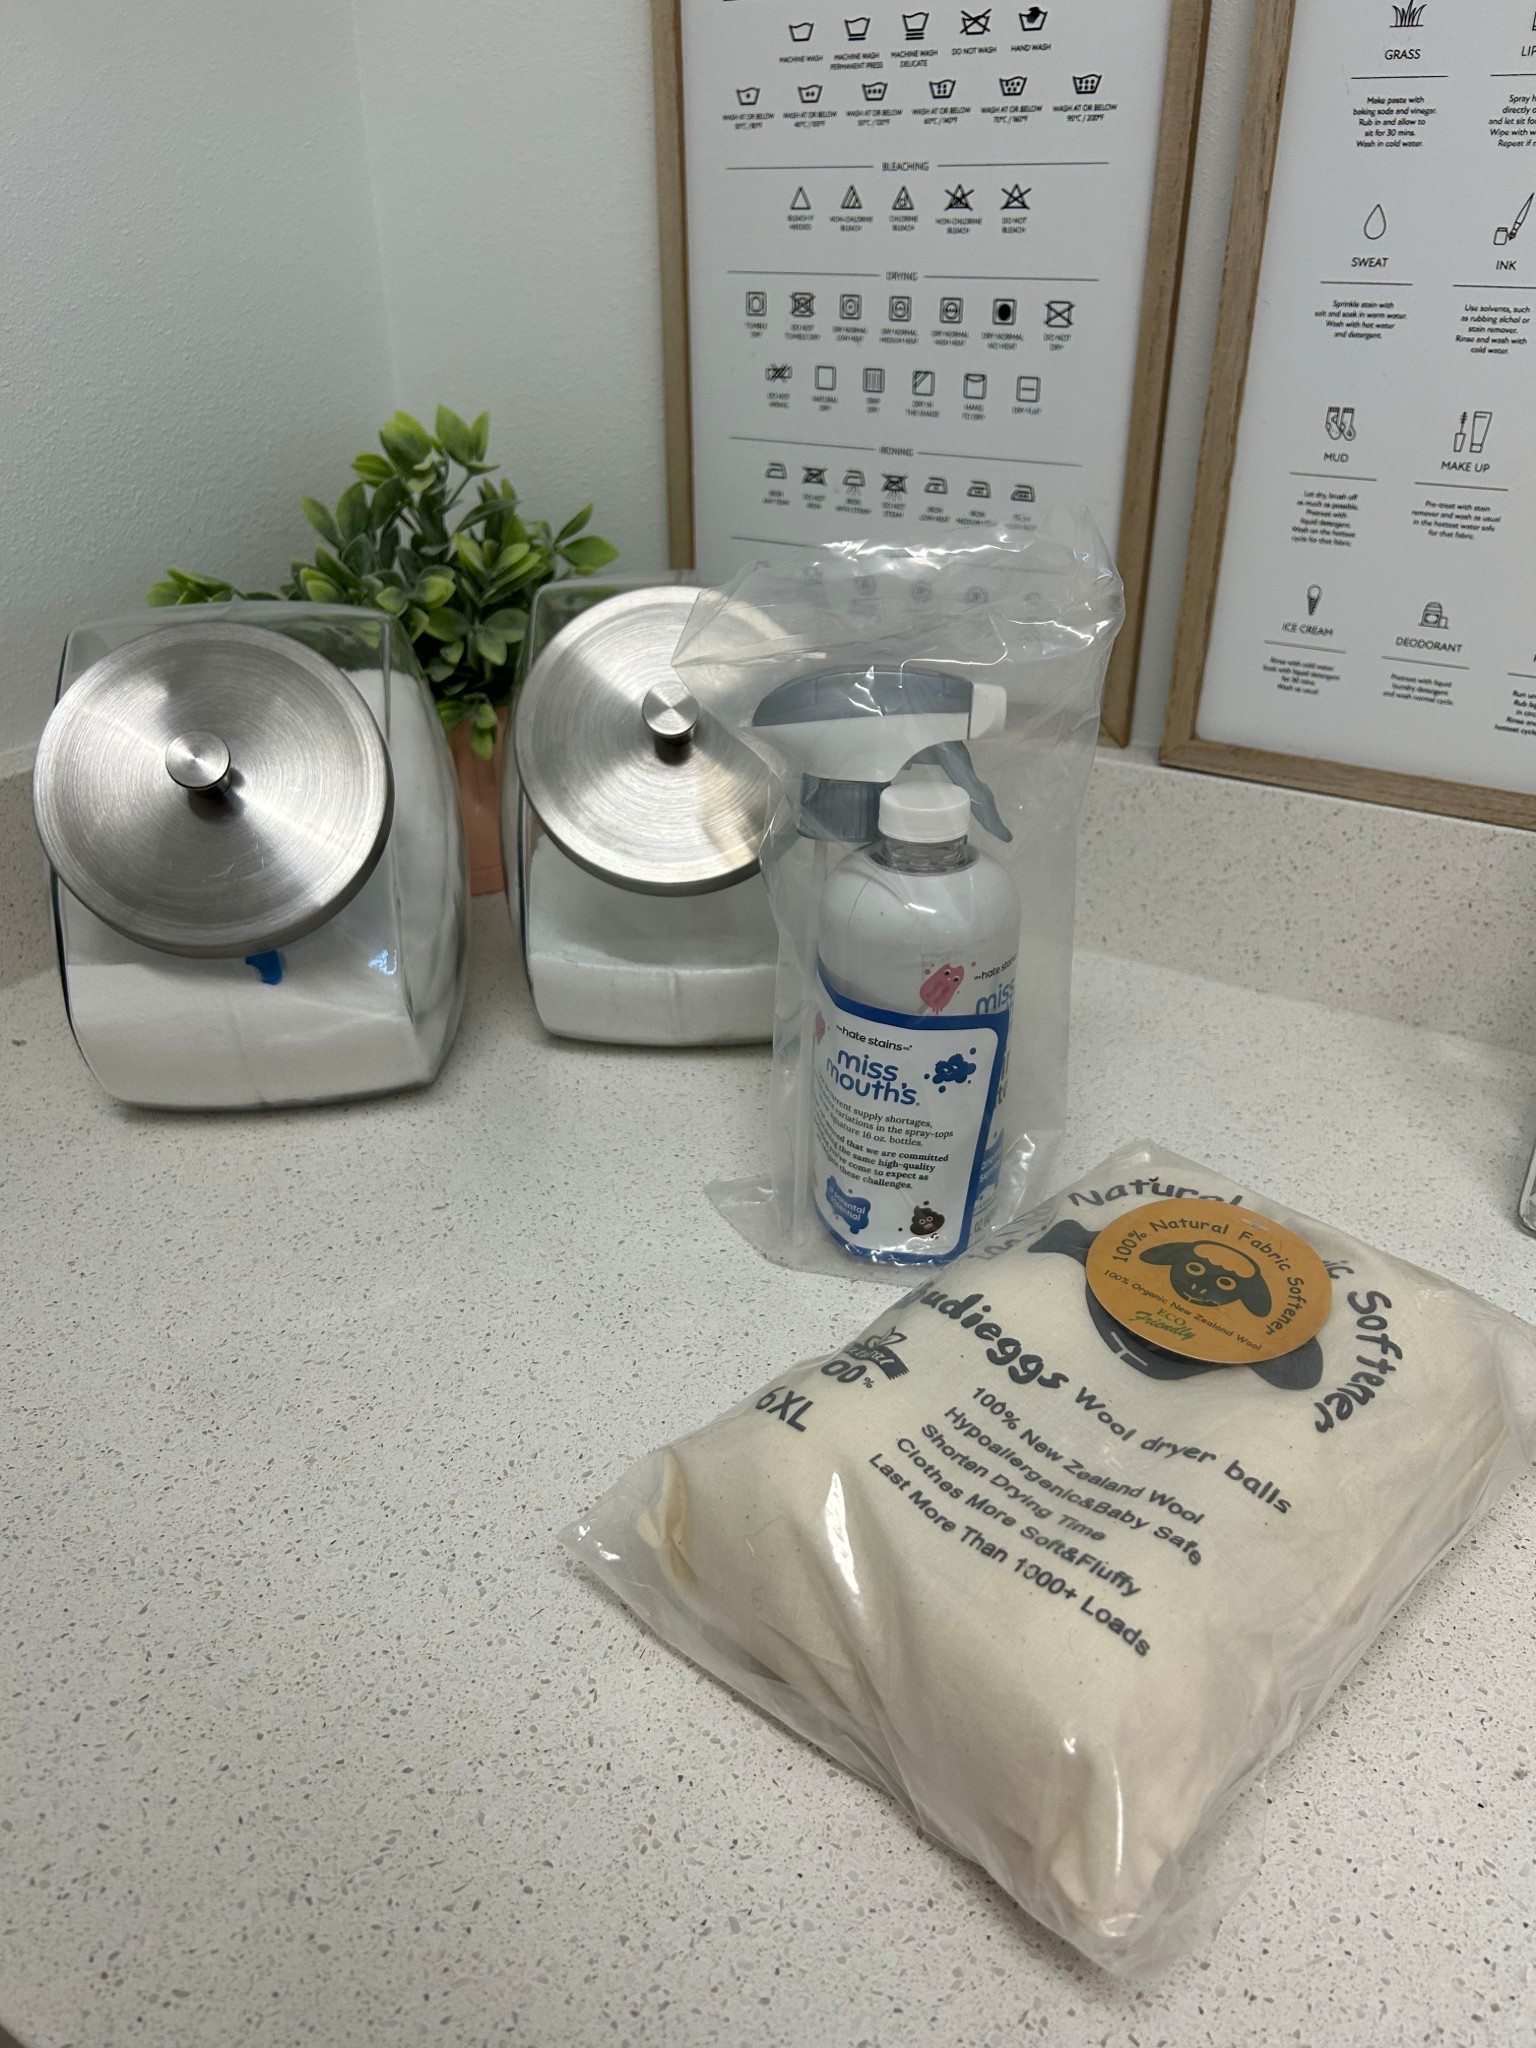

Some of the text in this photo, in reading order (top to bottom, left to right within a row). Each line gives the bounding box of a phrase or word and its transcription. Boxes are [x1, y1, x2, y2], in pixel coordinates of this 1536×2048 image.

[951, 46, 997, 56] DO NOT WASH
[1010, 43, 1052, 53] HAND WASH
[1384, 49, 1422, 60] GRASS
[899, 59, 928, 68] DELICATE
[1367, 96, 1386, 104] Make
[1387, 96, 1407, 105] paste
[1508, 94, 1530, 104] Spray
[1353, 108, 1376, 117] baking
[1396, 107, 1409, 115] and
[1502, 106, 1531, 115] directly
[1359, 118, 1426, 126] Rub in and allow to
[1488, 117, 1526, 125] and let sit
[1364, 129, 1374, 137] sit
[1374, 129, 1385, 137] for
[1386, 129, 1396, 137] 30
[1490, 128, 1528, 137] Wipe with
[1498, 139, 1524, 149] Repeat
[881, 162, 929, 172] BLEACHING
[1350, 257, 1389, 268] SWEAT
[1495, 260, 1518, 271] INK
[1333, 300, 1394, 310] Sprinkle stain with
[1481, 305, 1512, 315] solvents,
[1326, 320, 1344, 328] Wash
[1362, 321, 1374, 329] hot
[1470, 315, 1498, 326] rubbing
[1469, 326, 1486, 334] stain
[1456, 335, 1527, 345] Rinse and wash with
[1471, 346, 1486, 354] cold
[1323, 452, 1349, 463] MUD
[1440, 460, 1491, 473] MAKE UP
[1281, 621, 1335, 637] ICE CREAM
[1395, 636, 1464, 653] DEODORANT
[981, 966, 1001, 980] hate
[842, 1025, 903, 1051] hate stains
[837, 1050, 899, 1082] miss
[826, 1057, 917, 1105] mouth's
[853, 1108, 933, 1133] supply shortages,
[876, 1123, 885, 1133] in
[887, 1124, 903, 1135] the
[904, 1127, 954, 1140] spray-tops
[862, 1131, 924, 1147] 16 oz. bottles.
[846, 1139, 950, 1162] that we are committed
[838, 1144, 936, 1173] the same high-quality
[839, 1165, 913, 1190] these challenges.
[848, 1161, 872, 1174] come
[874, 1168, 884, 1177] to
[885, 1170, 917, 1181] expect
[1112, 1229, 1148, 1263] 100%
[1149, 1217, 1230, 1236] Natural
[1237, 1231, 1292, 1272] Fabric
[1265, 1276, 1306, 1336] Softener
[1103, 1268, 1263, 1352] 100% Organic New Zealand Wool
[1156, 1307, 1187, 1327] ECO
[1128, 1309, 1197, 1342] Friendly
[1314, 1289, 1404, 1434] Softener
[754, 1385, 815, 1433] 6XL
[971, 1385, 1207, 1526] 100% New Zealand Wool
[1074, 1386, 1137, 1443] Wool
[1139, 1435, 1217, 1464] dryer
[1223, 1459, 1294, 1516] balls
[920, 1421, 1107, 1543] Shorten Drying Time
[943, 1404, 1203, 1567] Hypoallergenic&Baby Safe
[896, 1436, 1143, 1599] Clothes More Soft&Fluffy
[867, 1452, 1152, 1659] Last More Than 1000+ Loads
